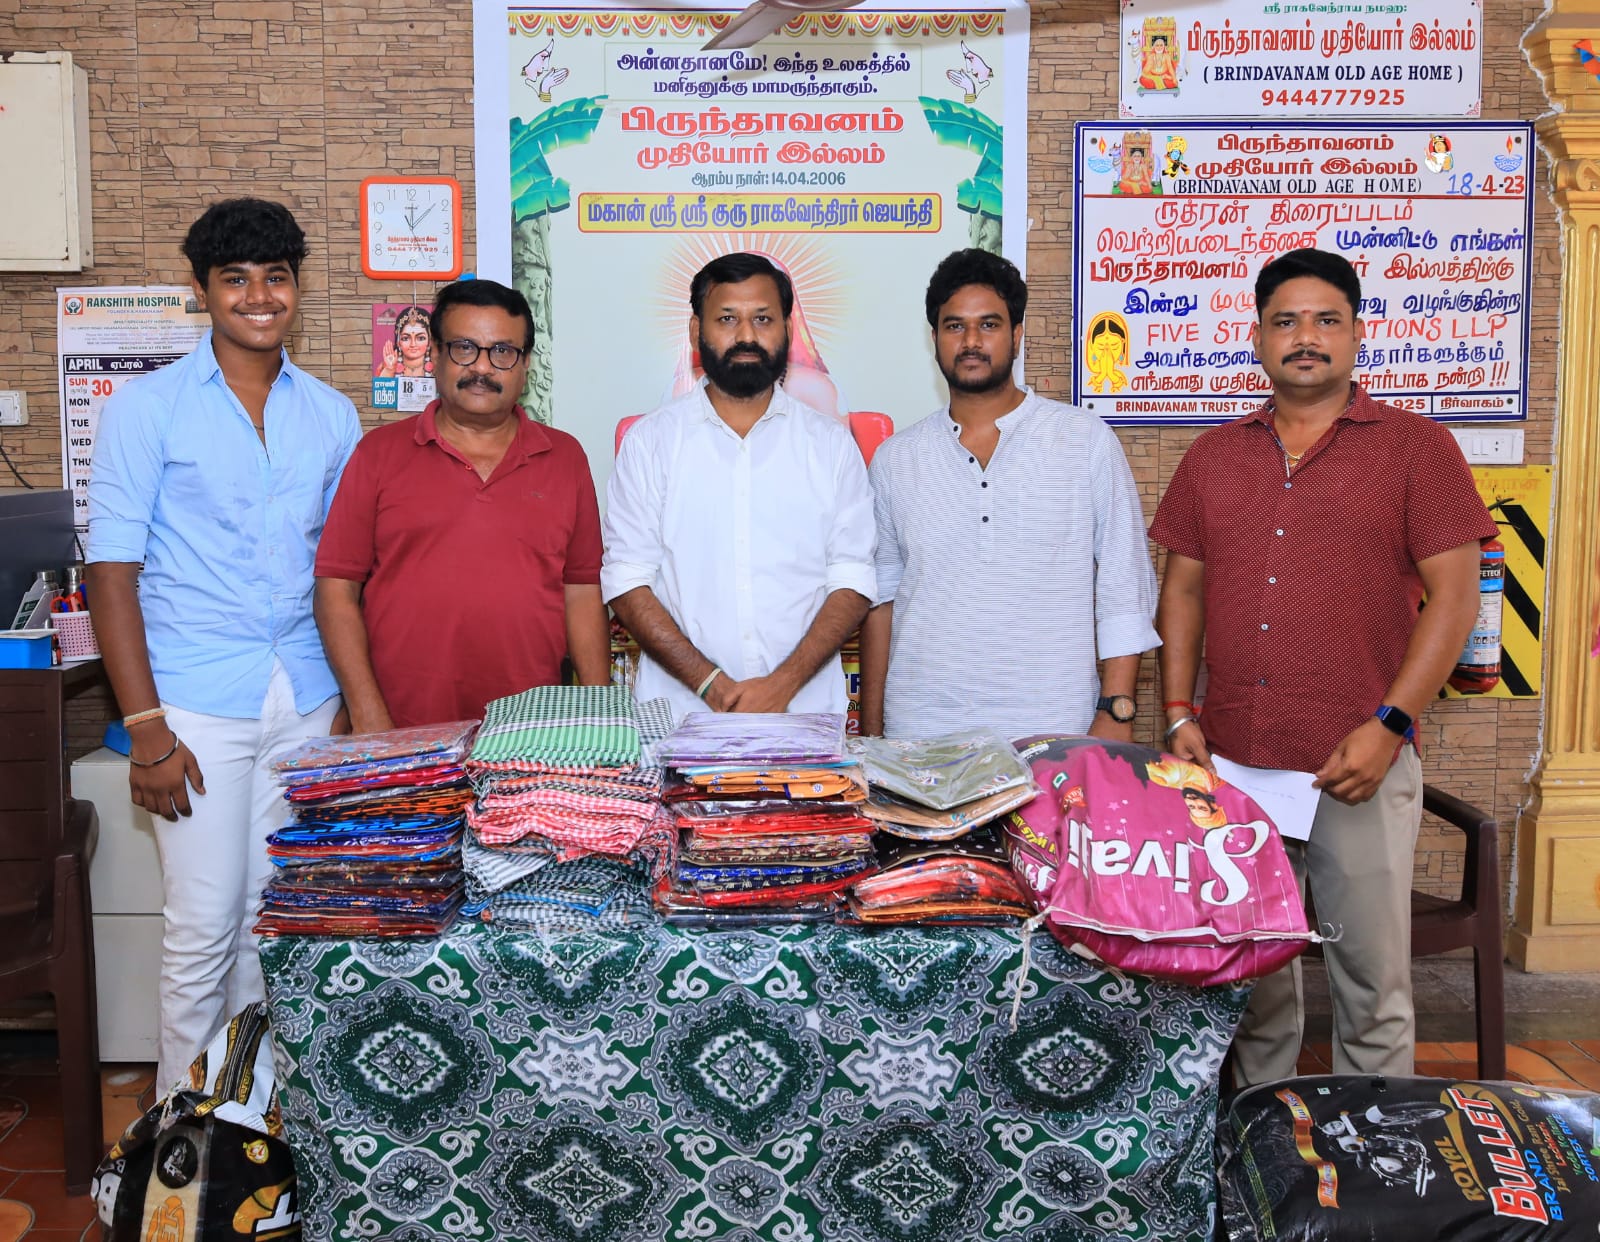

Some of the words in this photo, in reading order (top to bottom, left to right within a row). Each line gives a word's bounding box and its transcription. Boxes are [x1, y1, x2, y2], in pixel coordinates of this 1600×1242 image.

[1187, 19, 1315, 58] பிருந்தாவனம்
[1320, 19, 1404, 58] முதியோர்
[1410, 19, 1476, 51] இல்லம்
[617, 48, 768, 74] அன்னதானமே!
[774, 52, 818, 74] இந்த
[823, 52, 911, 74] உலகத்தில்
[1214, 65, 1330, 81] BRINDAVANAM
[1335, 65, 1365, 81] OLD
[1371, 65, 1402, 81] AGE
[1408, 65, 1453, 81] HOME
[653, 76, 748, 98] மனிதனுக்கு
[752, 75, 877, 97] மாமருந்தாகும்.
[1261, 89, 1405, 106] 9444777925
[621, 106, 904, 138] பிருந்தாவனம்
[636, 141, 769, 170] முதியோர்
[776, 141, 885, 165] இல்லம்
[1217, 134, 1394, 155] பிருந்தாவனம்
[1195, 157, 1314, 178] முதியோர்
[1320, 157, 1418, 175] இல்லம்
[692, 172, 734, 187] ஆரம்ப
[735, 170, 769, 189] நாள்:
[772, 172, 846, 185] 14.04.2006
[1173, 178, 1282, 196] (BRINDAVANAM
[1287, 179, 1316, 194] OLD
[1325, 178, 1354, 194] AGE
[1364, 177, 1422, 194] HOME)
[588, 197, 644, 222] மகான்
[712, 201, 747, 227] குரு
[751, 197, 859, 228] ராகவேந்திரர்
[862, 197, 933, 228] ஜெயந்தி
[1155, 198, 1250, 231] ருத்ரன்
[1265, 197, 1414, 231] திரைப்படம்
[1336, 226, 1438, 250] முன்னிட்டு
[1450, 228, 1524, 251] எங்கள்
[1384, 252, 1514, 283] இல்லத்திற்கு
[87, 297, 134, 307] RAKSHITH
[138, 297, 181, 307] HOSPITAL
[1123, 287, 1198, 317] இன்று
[1403, 288, 1521, 318] வழங்குகின்ற
[1147, 323, 1199, 346] FIVE
[1214, 320, 1257, 344] STA
[1452, 313, 1508, 339] LLP
[68, 359, 103, 371] APRIL
[110, 358, 143, 370] ஏப்ரல்
[1135, 347, 1262, 369] அவர்களுடை
[1354, 340, 1504, 370] த்தார்களுக்கும்
[69, 378, 88, 386] SUN
[92, 379, 112, 396] 30
[403, 381, 413, 393] 18
[1131, 371, 1203, 392] எங்களது
[1434, 367, 1486, 390] நன்றி
[1116, 401, 1197, 413] BRINDAVANAM
[1201, 401, 1238, 412] TRUST
[1241, 402, 1263, 412] Che
[1440, 397, 1504, 410] நிர்வாகம்
[71, 419, 89, 427] TUE
[72, 458, 91, 466] THU
[1480, 569, 1501, 577] FETECH
[1067, 818, 1270, 905] Sivaji
[1526, 1125, 1543, 1145] Ram
[1447, 1088, 1549, 1225] BULLET
[1569, 1138, 1599, 1183] SORTEX
[1434, 1136, 1486, 1201] ROYAL
[1524, 1149, 1563, 1221] BRAND
